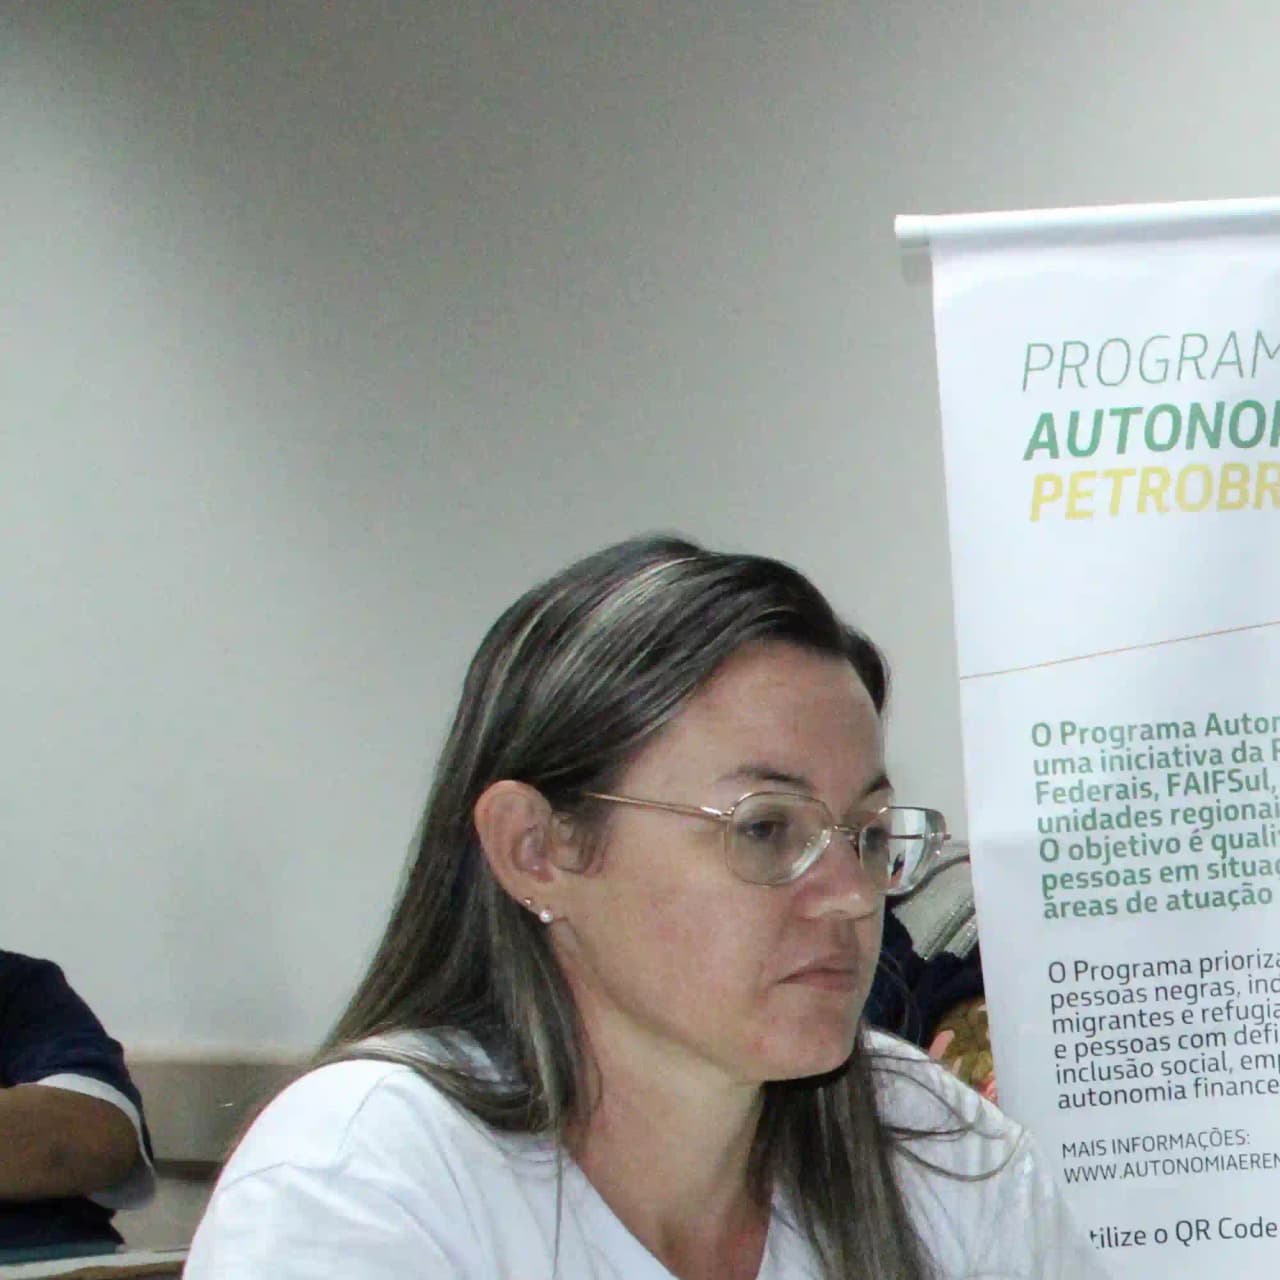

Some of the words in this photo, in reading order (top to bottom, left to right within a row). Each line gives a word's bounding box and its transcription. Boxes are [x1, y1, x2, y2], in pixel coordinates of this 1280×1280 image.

[1031, 722, 1051, 746] O
[1060, 721, 1197, 747] Programa
[1034, 756, 1093, 775] uma
[1100, 744, 1224, 772] iniciativa
[1231, 740, 1264, 764] da
[1035, 776, 1159, 804] Federais,
[1167, 768, 1276, 797] FAIFSul,
[1037, 805, 1163, 832] unidades
[1040, 837, 1060, 862] O
[1068, 832, 1181, 864] objetivo
[1188, 828, 1206, 853] é
[1041, 868, 1152, 896] pessoas
[1160, 863, 1199, 883] em
[1042, 891, 1118, 917] áreas
[1126, 890, 1157, 913] de
[1166, 882, 1272, 911] atuação
[1048, 960, 1066, 983] O
[1074, 960, 1193, 985] Programa
[1050, 987, 1147, 1013] pessoas
[1155, 983, 1240, 1006] negras,
[1052, 1009, 1175, 1037] migrantes
[1181, 1010, 1194, 1024] e
[1054, 1044, 1067, 1059] e
[1075, 1036, 1171, 1063] pessoas
[1178, 1034, 1227, 1050] com
[1056, 1058, 1154, 1084] inclusão
[1161, 1051, 1234, 1076] social,
[1058, 1080, 1188, 1108] autonomia
[1062, 1139, 1107, 1158] MAIS
[1112, 1127, 1250, 1154] INFORMAÇÕES:
[1089, 1226, 1147, 1248] tilize
[1154, 1228, 1168, 1244] o
[1175, 1220, 1212, 1247] QR
[1218, 1218, 1277, 1239] Code
